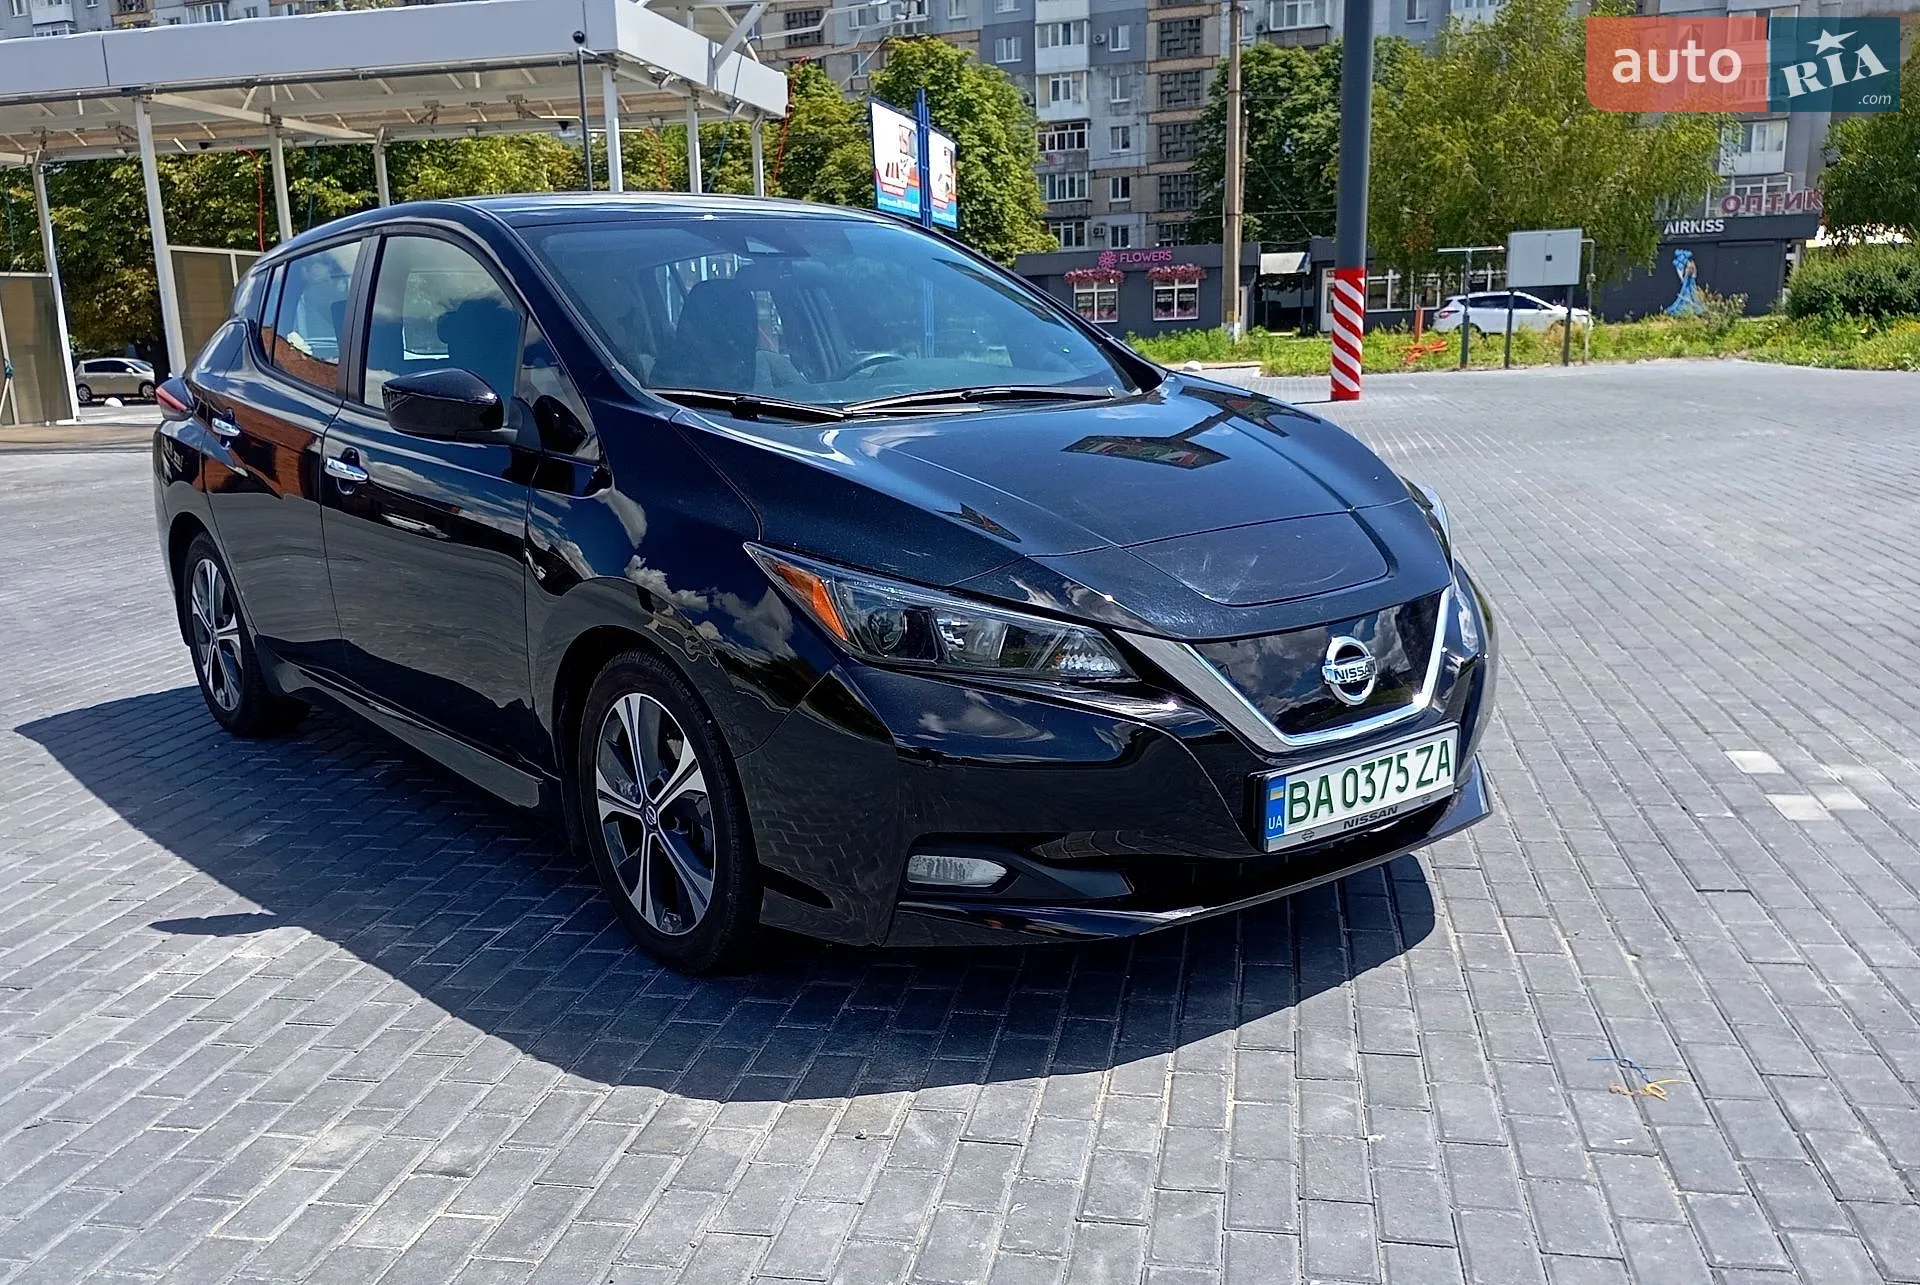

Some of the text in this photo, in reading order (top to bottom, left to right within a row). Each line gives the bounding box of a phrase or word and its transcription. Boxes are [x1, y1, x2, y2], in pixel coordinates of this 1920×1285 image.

[1664, 219, 1724, 235] AIRKISS
[1120, 250, 1172, 263] FLOWERS
[1288, 740, 1451, 825] BA 0375 ZA
[1268, 815, 1283, 829] UA
[1343, 806, 1398, 829] NISSAN
